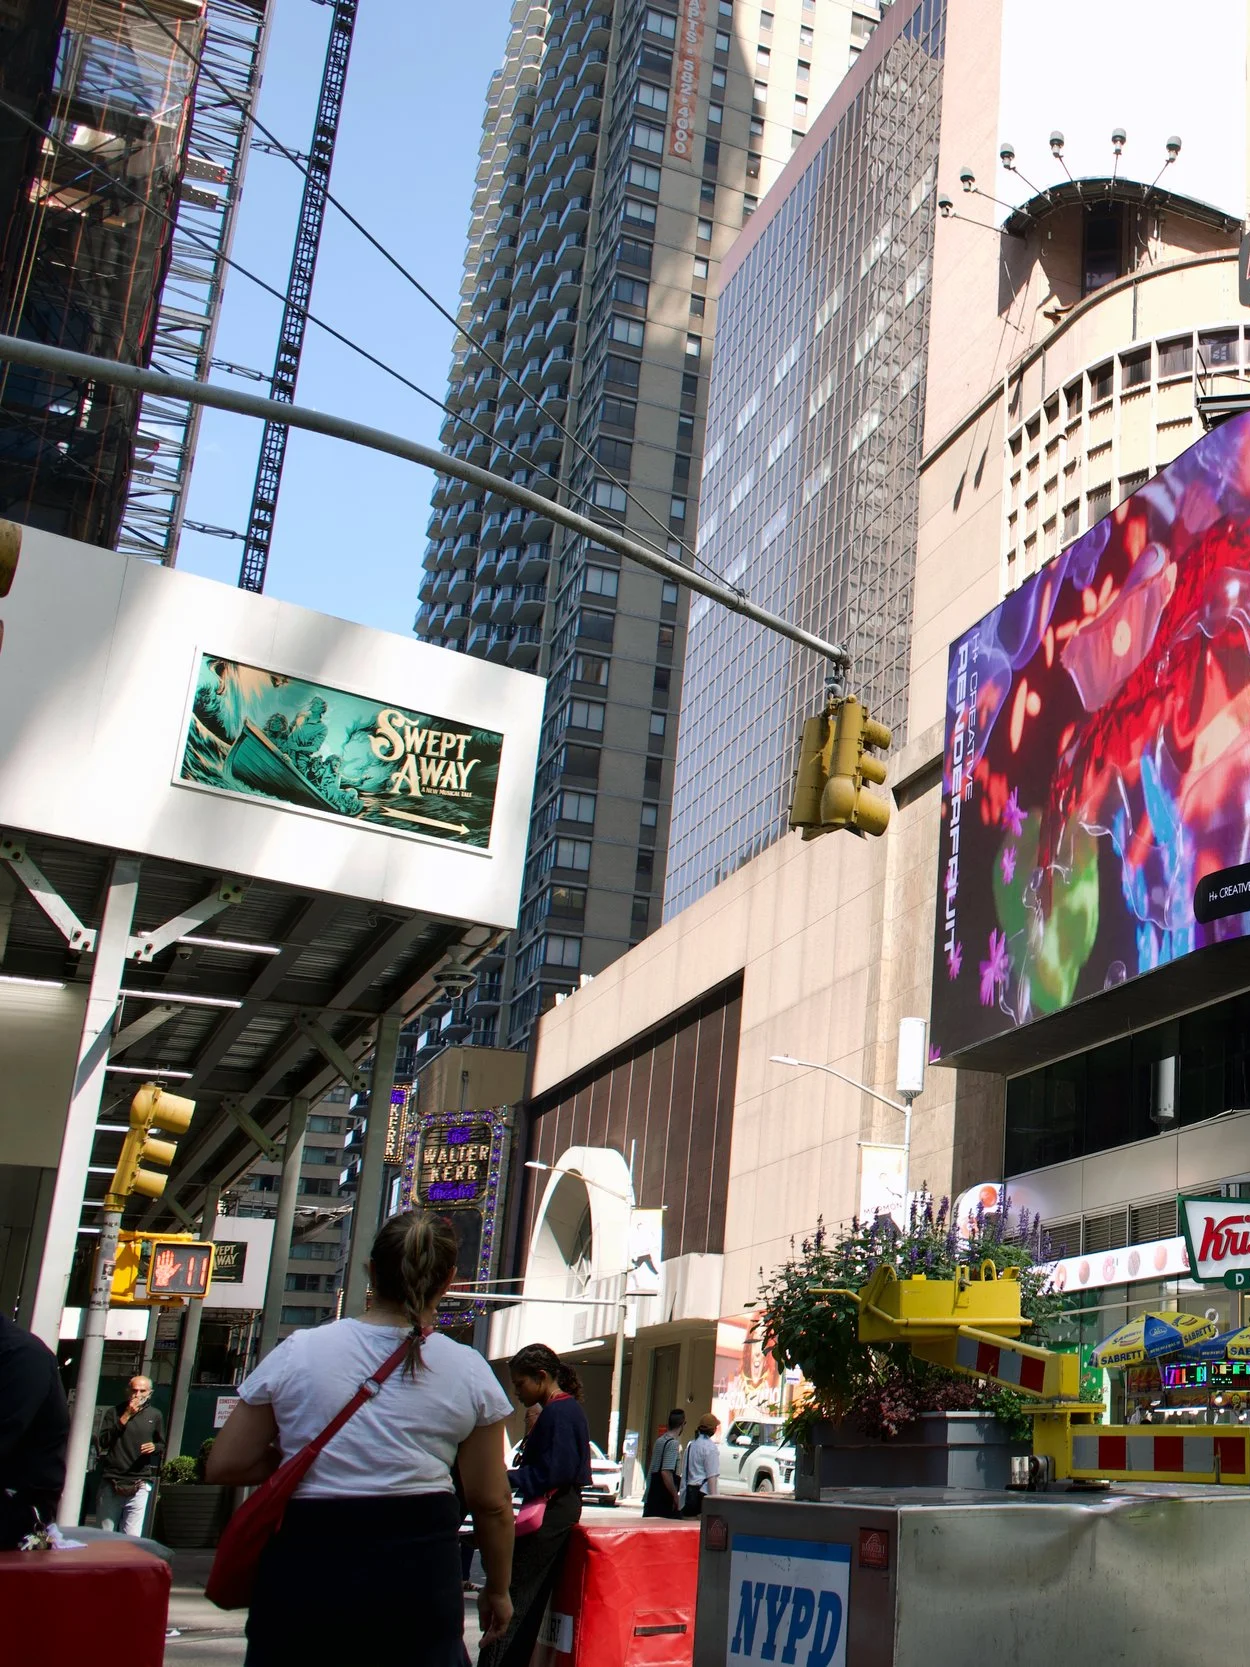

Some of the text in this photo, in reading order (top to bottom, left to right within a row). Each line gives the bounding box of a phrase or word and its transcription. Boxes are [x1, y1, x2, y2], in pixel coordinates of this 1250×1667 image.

[368, 708, 472, 762] SWEPT
[964, 670, 978, 803] CREATIVE
[389, 753, 482, 797] AWAY
[385, 1103, 400, 1156] KERR
[423, 1145, 489, 1163] WALTER
[430, 1164, 478, 1182] KERR
[186, 1256, 208, 1287] 11
[1183, 1323, 1212, 1344] SABRETT
[1101, 1350, 1142, 1365] SABRETT
[730, 1580, 843, 1667] NYPD
